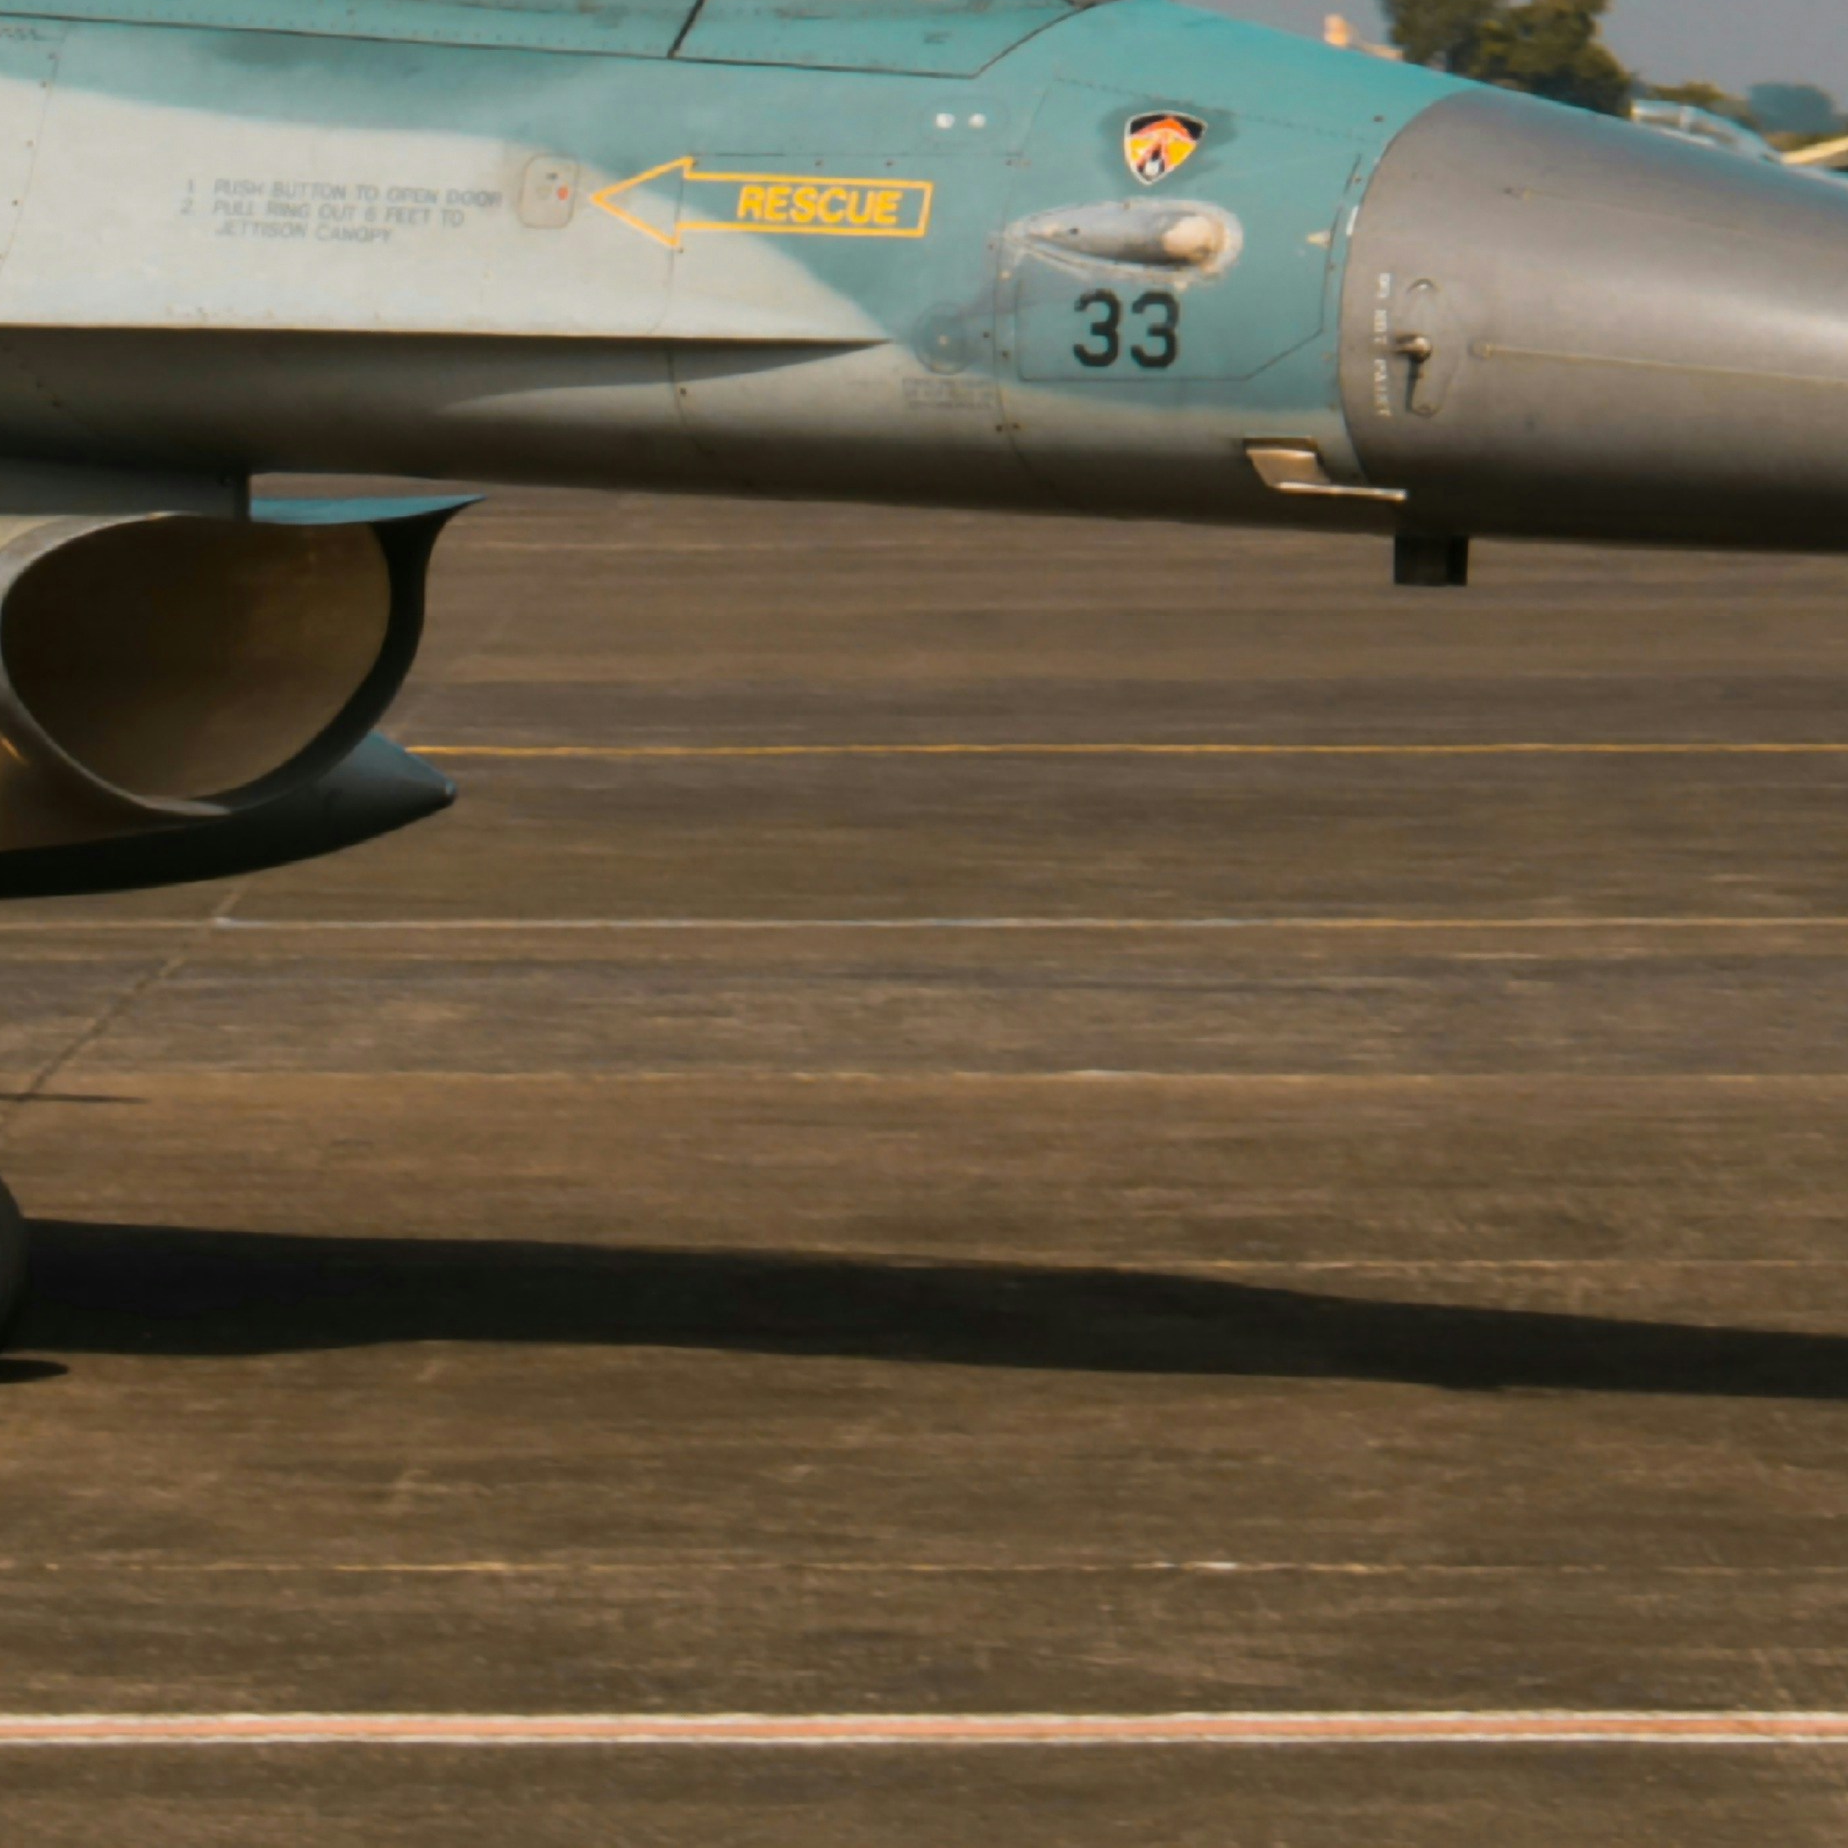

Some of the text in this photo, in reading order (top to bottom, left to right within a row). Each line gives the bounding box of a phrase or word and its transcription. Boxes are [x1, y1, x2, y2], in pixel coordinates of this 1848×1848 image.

[213, 178, 265, 196] PUSH
[271, 180, 347, 201] BUTTON
[355, 184, 380, 202] TO
[386, 186, 439, 205] OPEN
[445, 188, 503, 208] DOOR
[736, 183, 904, 225] RESCUE
[211, 199, 254, 218] PULL
[266, 200, 310, 219] RING
[317, 202, 357, 221] OUT
[384, 205, 431, 225] FEET
[440, 208, 466, 228] TO
[214, 218, 394, 244] JETTISON CANOPY
[1073, 287, 1180, 369] 33
